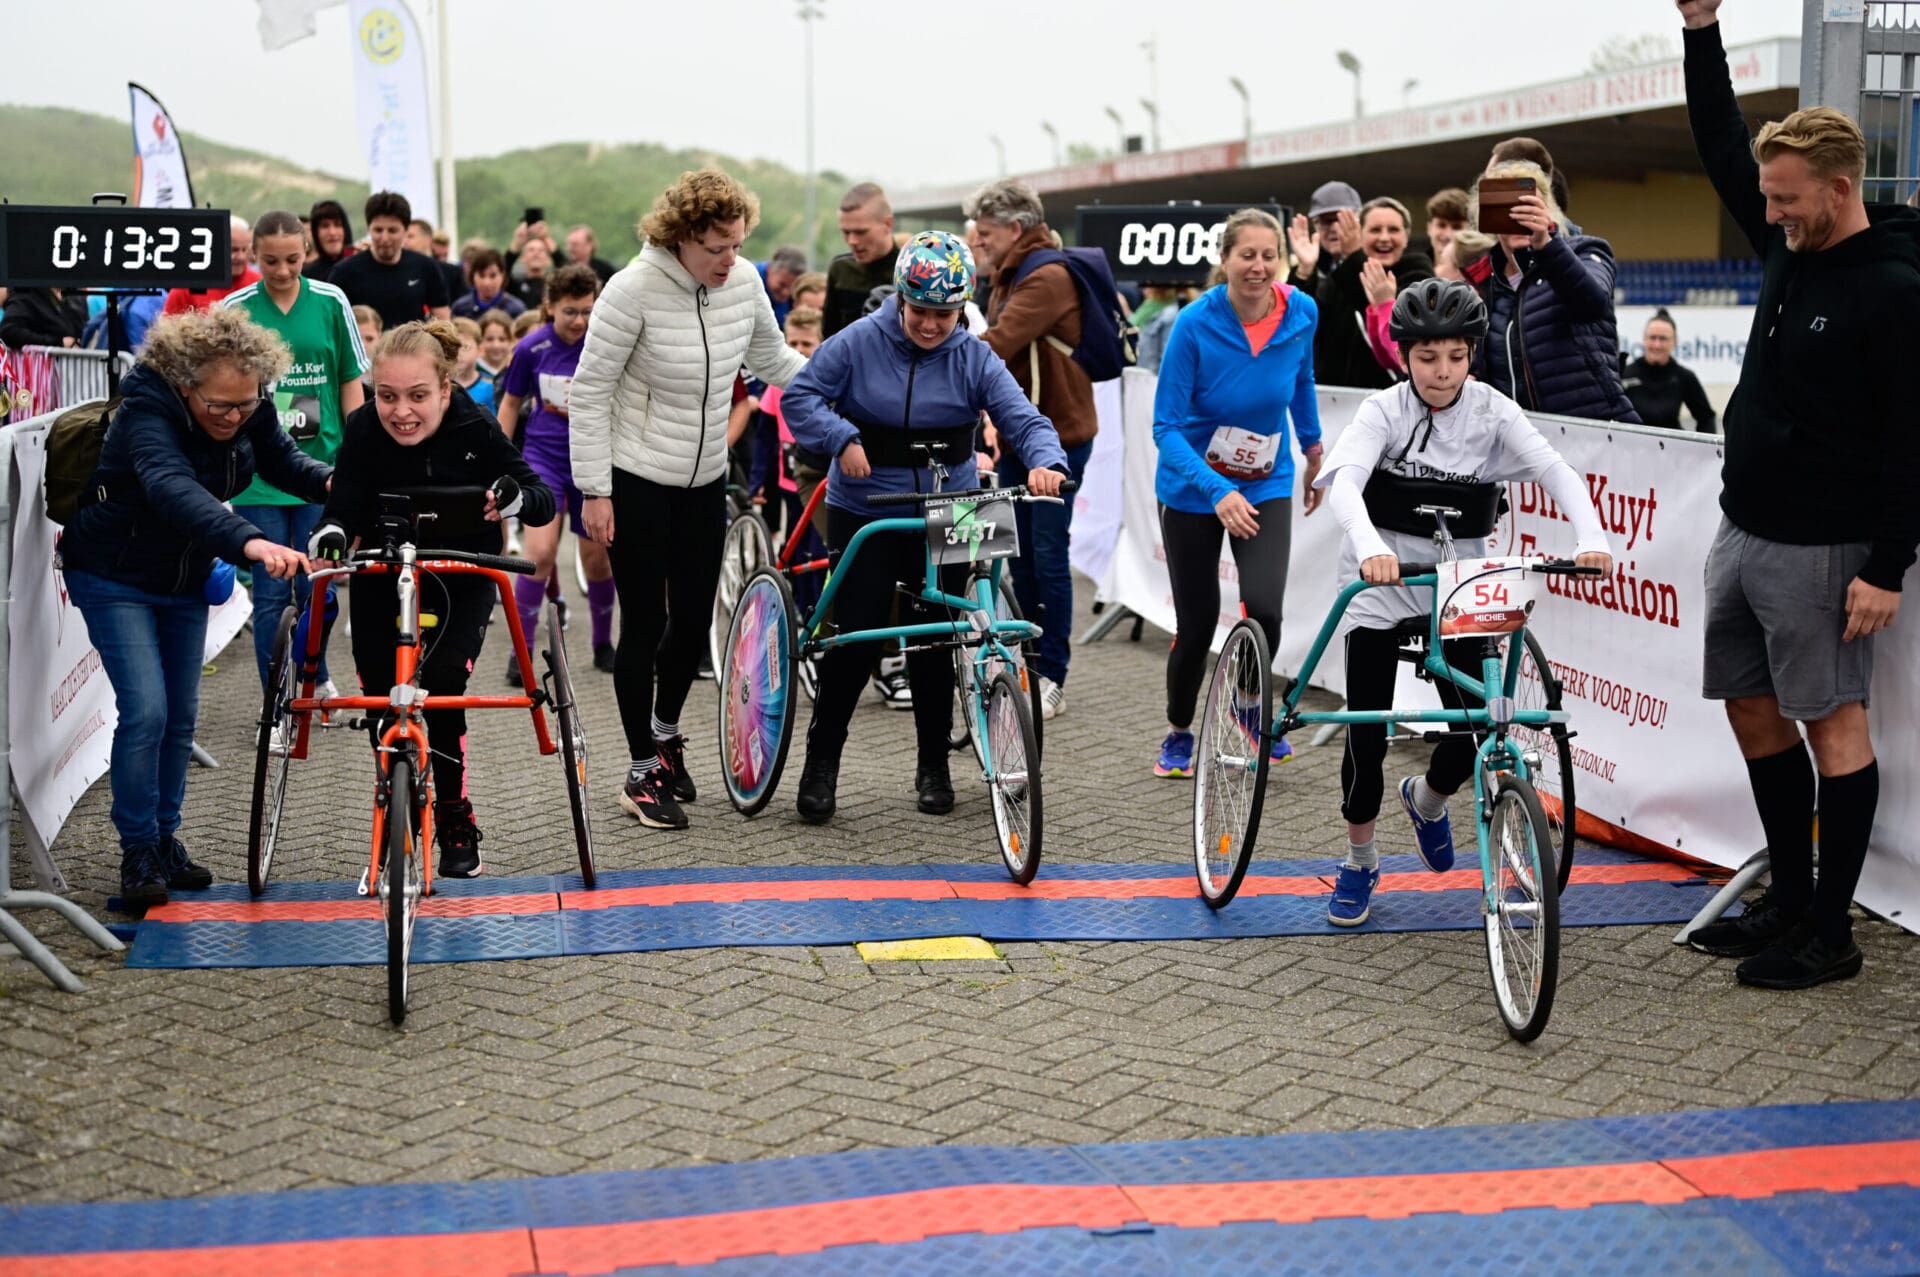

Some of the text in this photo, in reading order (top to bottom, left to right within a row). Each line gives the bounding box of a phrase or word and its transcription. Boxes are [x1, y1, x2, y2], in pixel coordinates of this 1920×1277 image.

[1606, 66, 1685, 107] BOEKETT
[52, 226, 213, 270] 0:13:23
[1119, 223, 1227, 265] 0:00:0
[1232, 447, 1258, 465] 55
[1519, 473, 1657, 550] Di Kuyt
[944, 521, 996, 545] 5737
[1474, 583, 1508, 607] 54
[1520, 533, 1680, 628] Funation
[1474, 613, 1507, 622] MICHIEL
[1592, 676, 1632, 716] VOOR
[1628, 692, 1669, 730] JOU!
